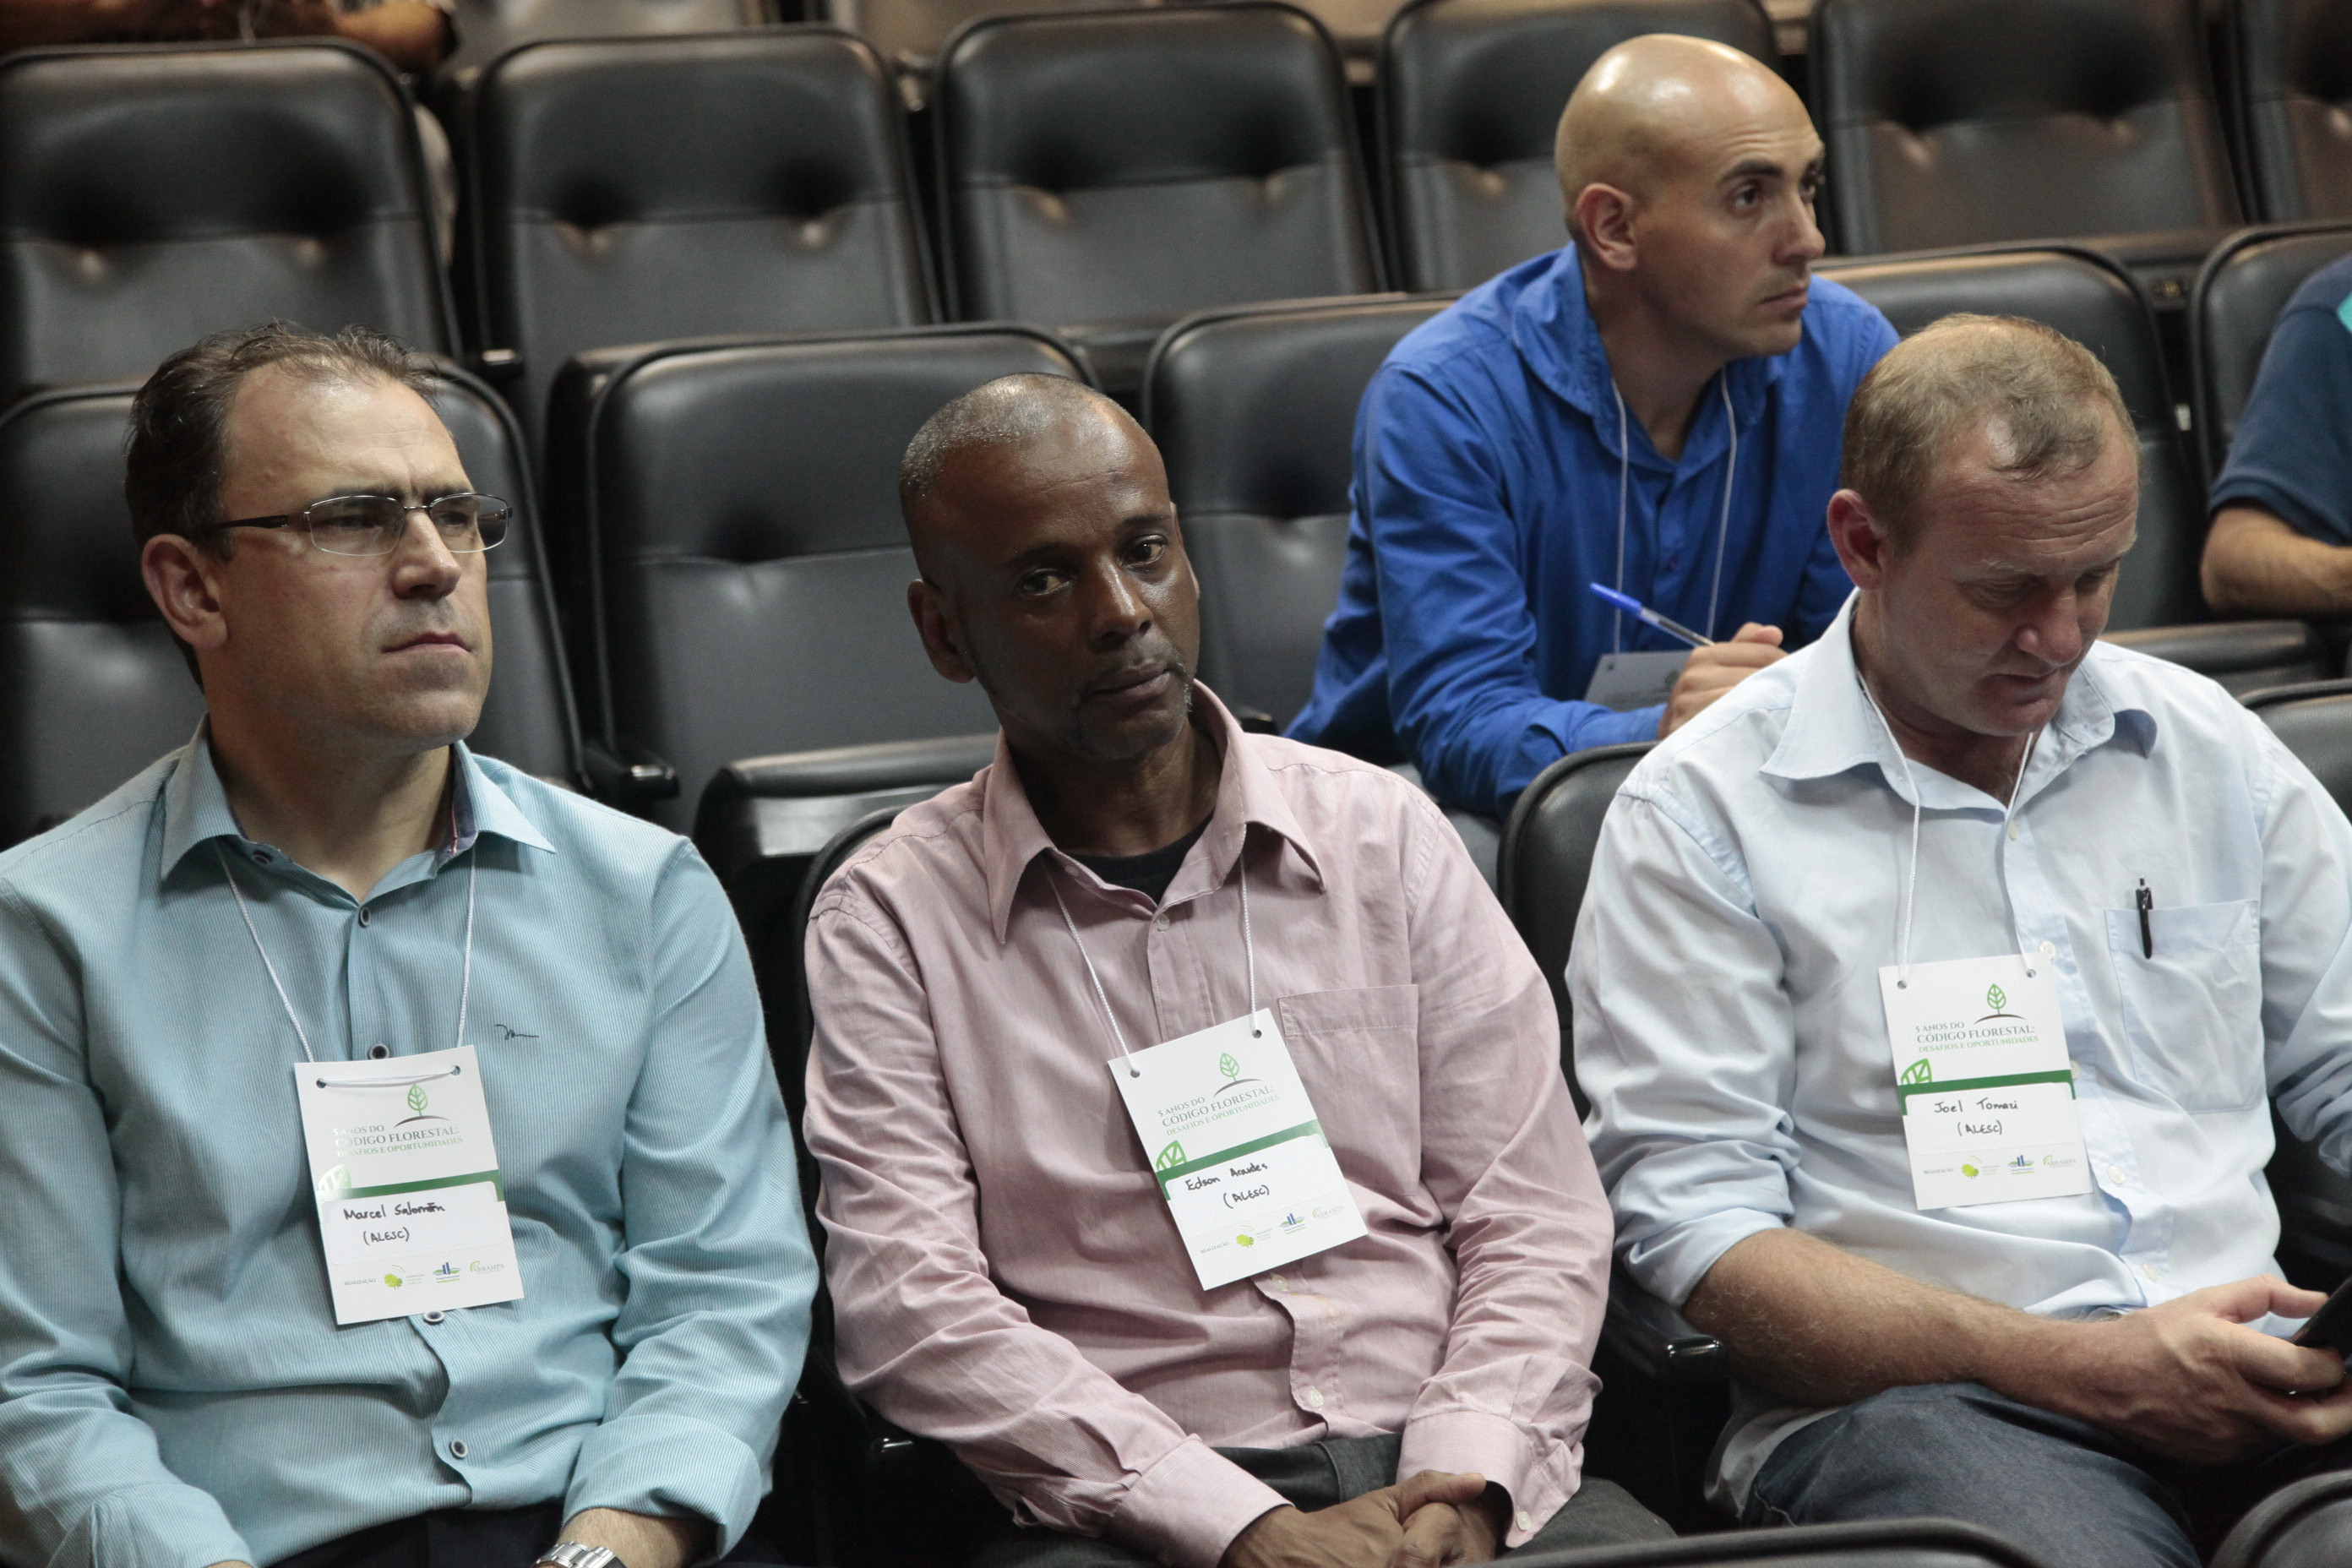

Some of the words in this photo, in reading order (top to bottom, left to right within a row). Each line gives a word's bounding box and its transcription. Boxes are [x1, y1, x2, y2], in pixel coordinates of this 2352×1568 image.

[1923, 1023, 1948, 1032] ANOS
[1917, 1031, 1966, 1044] CÓDIGO
[1919, 1043, 1959, 1053] DESAFIOS
[1967, 1036, 2039, 1048] OPORTUNIDADES
[1162, 1106, 1209, 1127] CÓDIGO
[1211, 1085, 1275, 1112] FLORESTAL:
[1165, 1102, 1190, 1115] ANOS
[1190, 1097, 1206, 1107] DO
[1934, 1100, 1963, 1113] Joel
[1166, 1119, 1205, 1135] DESAFIOS
[1211, 1094, 1280, 1121] OPORTUNIDADES
[332, 1128, 339, 1136] 5
[340, 1125, 368, 1135] ANOS
[369, 1124, 384, 1133] DO
[1957, 1119, 2002, 1136] (ALESC)
[387, 1137, 464, 1152] OPORTUNIDADES
[1184, 1176, 1221, 1190] Edson
[1223, 1184, 1270, 1209] (ALESC)
[343, 1204, 386, 1220] Marcel
[363, 1227, 410, 1246] (ALESC)
